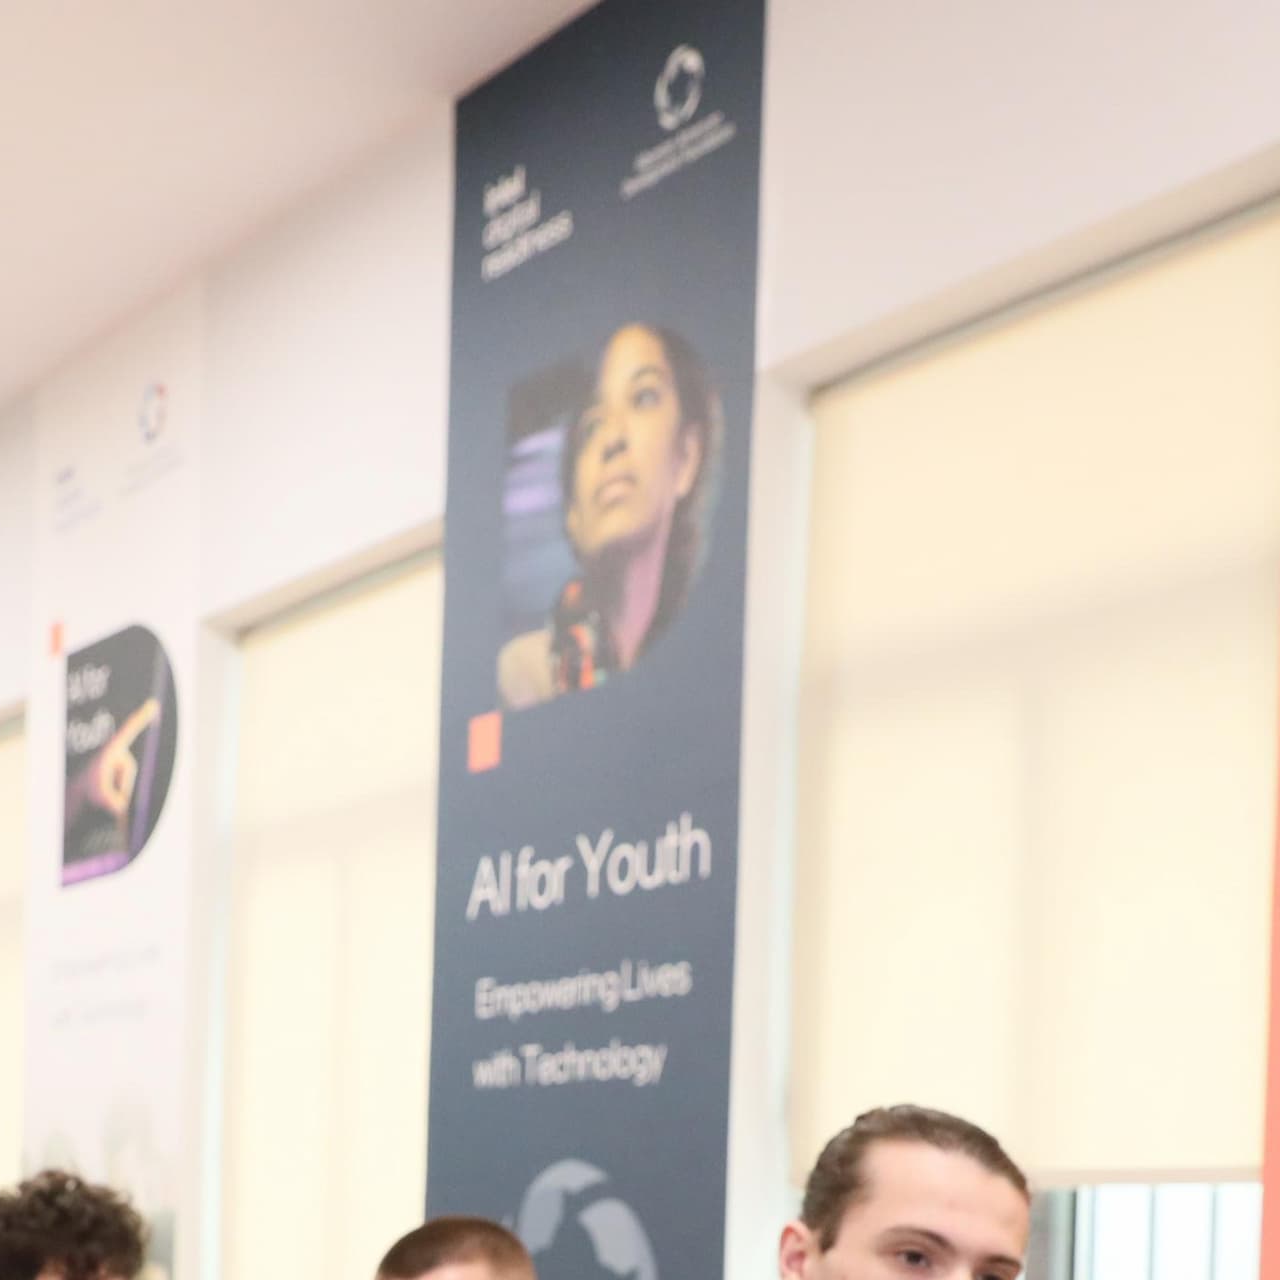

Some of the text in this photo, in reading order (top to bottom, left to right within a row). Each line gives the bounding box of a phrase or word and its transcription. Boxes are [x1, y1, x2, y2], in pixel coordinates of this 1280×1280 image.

[465, 811, 712, 921] AI for Youth
[474, 958, 694, 1022] Empowering Lives
[521, 1037, 669, 1088] Technology
